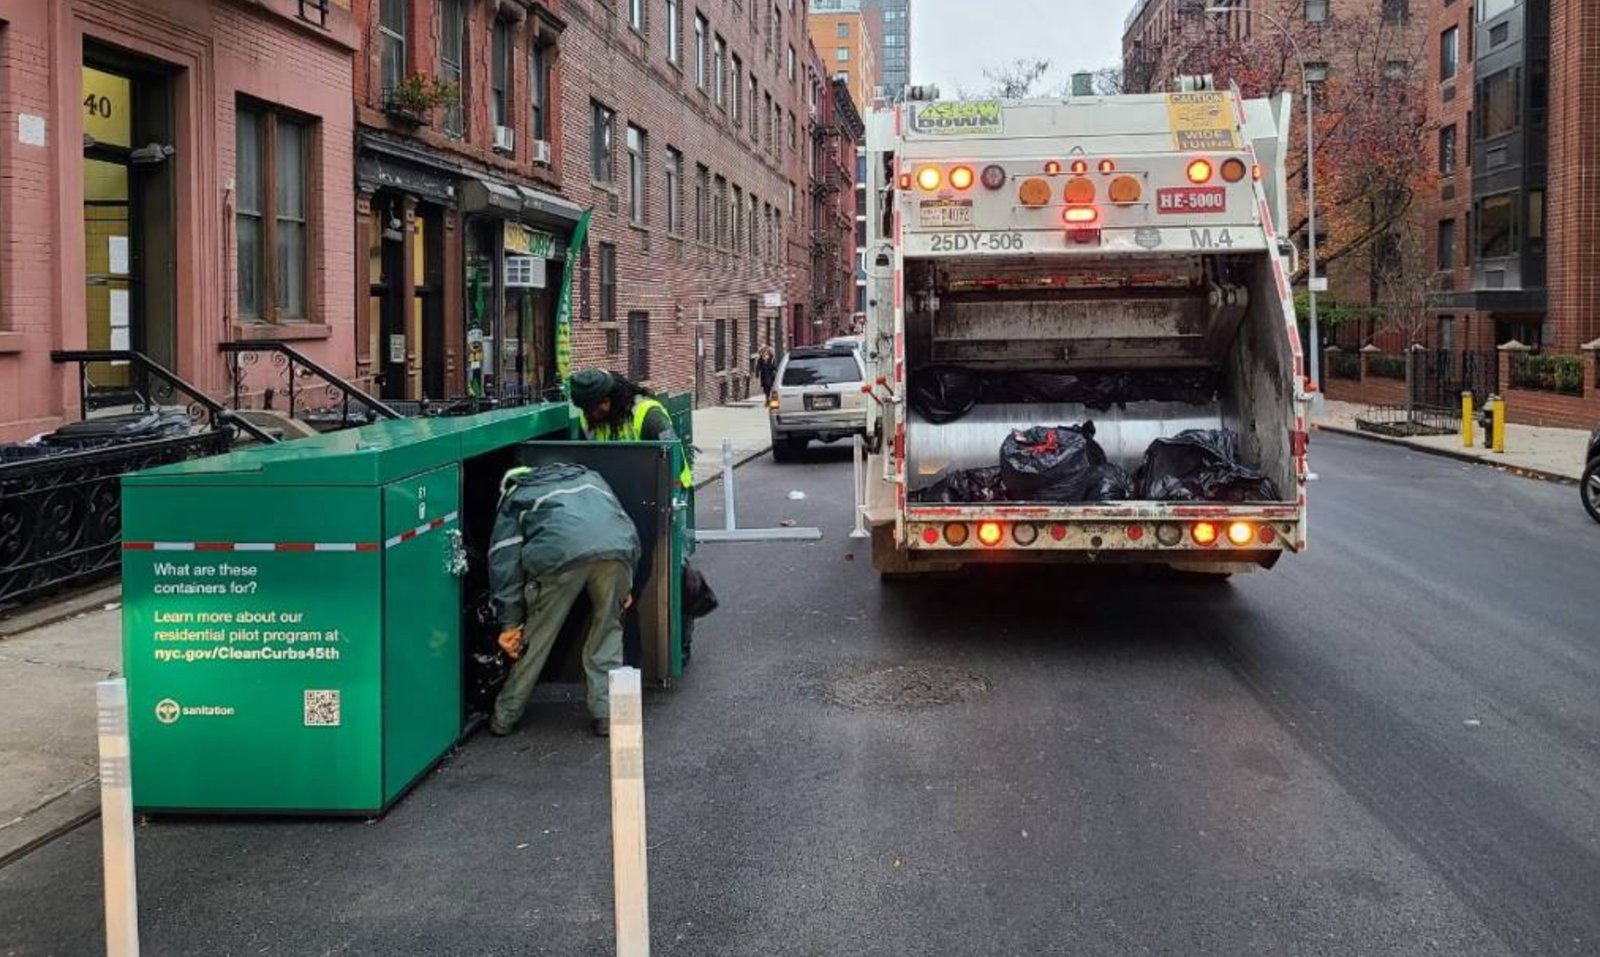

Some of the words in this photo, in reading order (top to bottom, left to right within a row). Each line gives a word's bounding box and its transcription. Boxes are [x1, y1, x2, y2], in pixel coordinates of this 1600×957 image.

[1172, 94, 1223, 103] CAUTION
[83, 94, 111, 119] 40
[918, 116, 999, 128] DOWN
[1184, 130, 1223, 139] WIDE
[1160, 193, 1222, 208] HE-5000
[931, 233, 1023, 251] 25DY-506
[1190, 228, 1234, 248] M.4
[154, 563, 190, 576] What
[194, 565, 216, 576] are
[219, 563, 257, 576] these
[154, 581, 226, 594] containers
[230, 581, 257, 594] for?
[154, 611, 194, 623] Learn
[197, 613, 232, 623] more
[236, 611, 276, 623] about
[280, 613, 303, 623] our
[154, 629, 225, 641] residential
[229, 629, 259, 643] pilot
[263, 631, 322, 644] program
[325, 630, 339, 641] at
[154, 647, 340, 662] nyc.gov/CleanCurbs45th
[182, 705, 235, 716] sanitation
